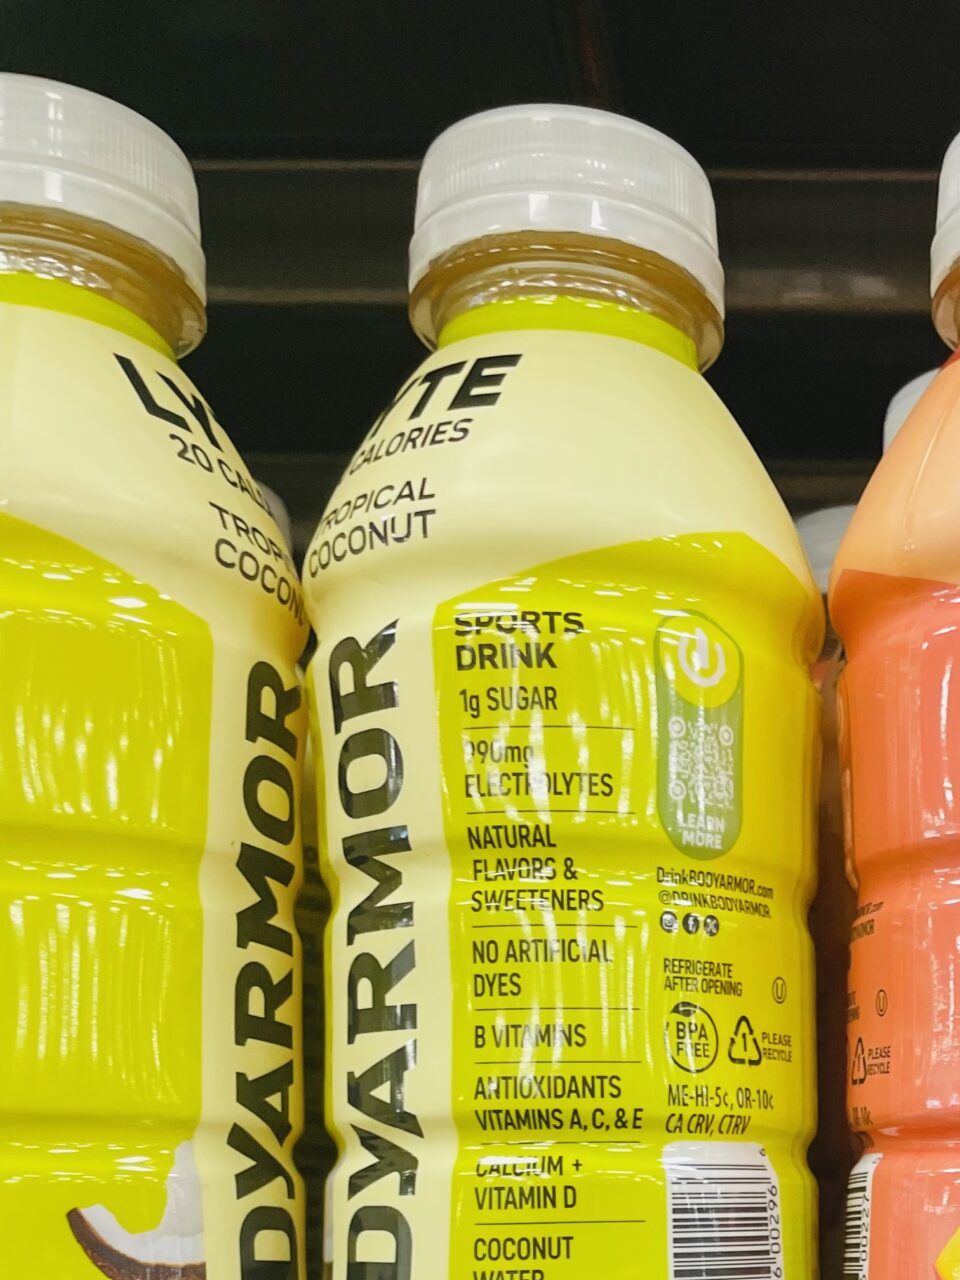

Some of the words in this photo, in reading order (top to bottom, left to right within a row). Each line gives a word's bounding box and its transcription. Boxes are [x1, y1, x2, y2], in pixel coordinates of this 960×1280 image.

[169, 433, 213, 474] 20
[309, 509, 436, 578] COCONUT
[454, 611, 584, 637] SPORTS
[455, 643, 557, 670] DRINK
[459, 688, 480, 718] 1g
[487, 686, 557, 712] SUGAR
[465, 773, 613, 798] ELECTLYTES
[678, 812, 726, 833] LEARN
[467, 824, 556, 849] NATURAL
[682, 831, 723, 850] MORE
[473, 857, 556, 881] FLAVORS
[563, 857, 578, 880] &
[471, 889, 604, 912] SWEETENERS
[472, 940, 499, 964] NO
[504, 939, 613, 963] ARTIFICIAL
[663, 958, 734, 979] REFRIGERATE
[474, 973, 521, 997] DYES
[664, 976, 699, 992] AFTER
[700, 978, 743, 997] OPENING
[474, 1026, 485, 1048] B
[492, 1024, 586, 1048] VITAMINS
[676, 1021, 708, 1041] BPA
[762, 1031, 792, 1047] PLEASE
[763, 1046, 793, 1063] RECYCLE
[867, 1046, 891, 1060] PLEASE
[474, 1075, 622, 1100] ANTIOXIDANTS
[474, 1109, 564, 1131] VITAMINS
[570, 1108, 588, 1131] A,
[592, 1108, 610, 1131] C,
[614, 1108, 628, 1129] &
[632, 1108, 644, 1130] E
[665, 1113, 684, 1134] CA
[718, 1114, 751, 1135] CTRV
[476, 1156, 564, 1177] CALCIUM
[475, 1186, 556, 1210] VITAMIN
[564, 1185, 577, 1209] D
[474, 1236, 574, 1261] COCONUT
